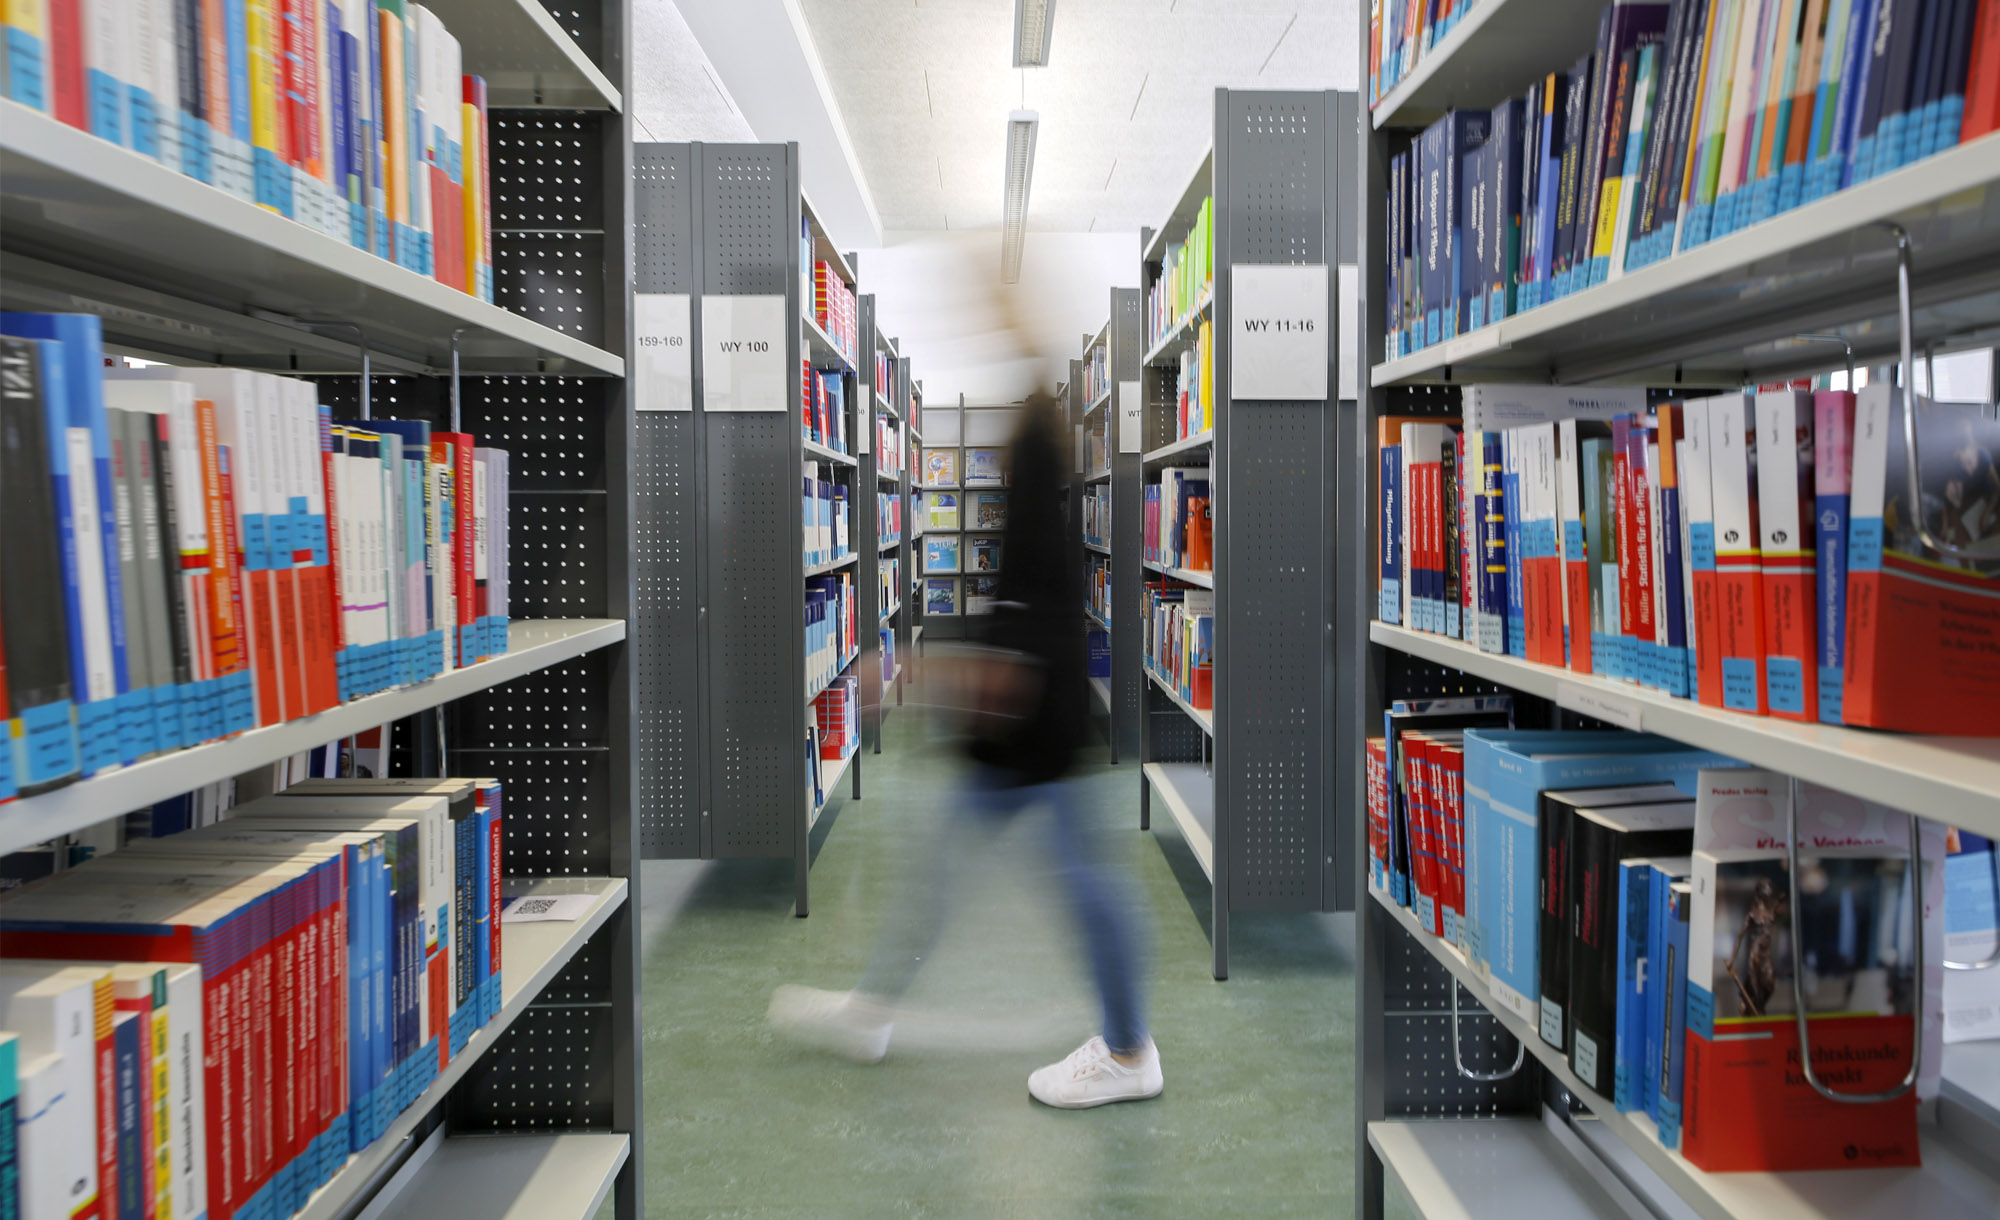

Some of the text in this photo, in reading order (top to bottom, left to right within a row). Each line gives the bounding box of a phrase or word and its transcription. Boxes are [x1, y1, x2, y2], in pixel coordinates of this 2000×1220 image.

[1428, 170, 1439, 272] Endspurt Pflege
[638, 336, 683, 347] 159-160
[1245, 319, 1314, 332] WY 11-16
[720, 342, 769, 353] WY 100
[202, 408, 225, 568] Menschliche Kommunikation
[1618, 485, 1626, 498] der
[462, 446, 473, 571] ENERGIEKOMPETENZ
[1385, 489, 1394, 564] Pflegeforschung
[1618, 509, 1630, 579] Pflegewissenschaft
[1635, 475, 1650, 623] Müller Statistik für die Pflege
[1498, 759, 1515, 772] Band
[262, 954, 272, 984] Pflege
[284, 940, 294, 970] Pflege
[218, 982, 230, 1016] Pflege
[240, 968, 252, 1000] Pflege
